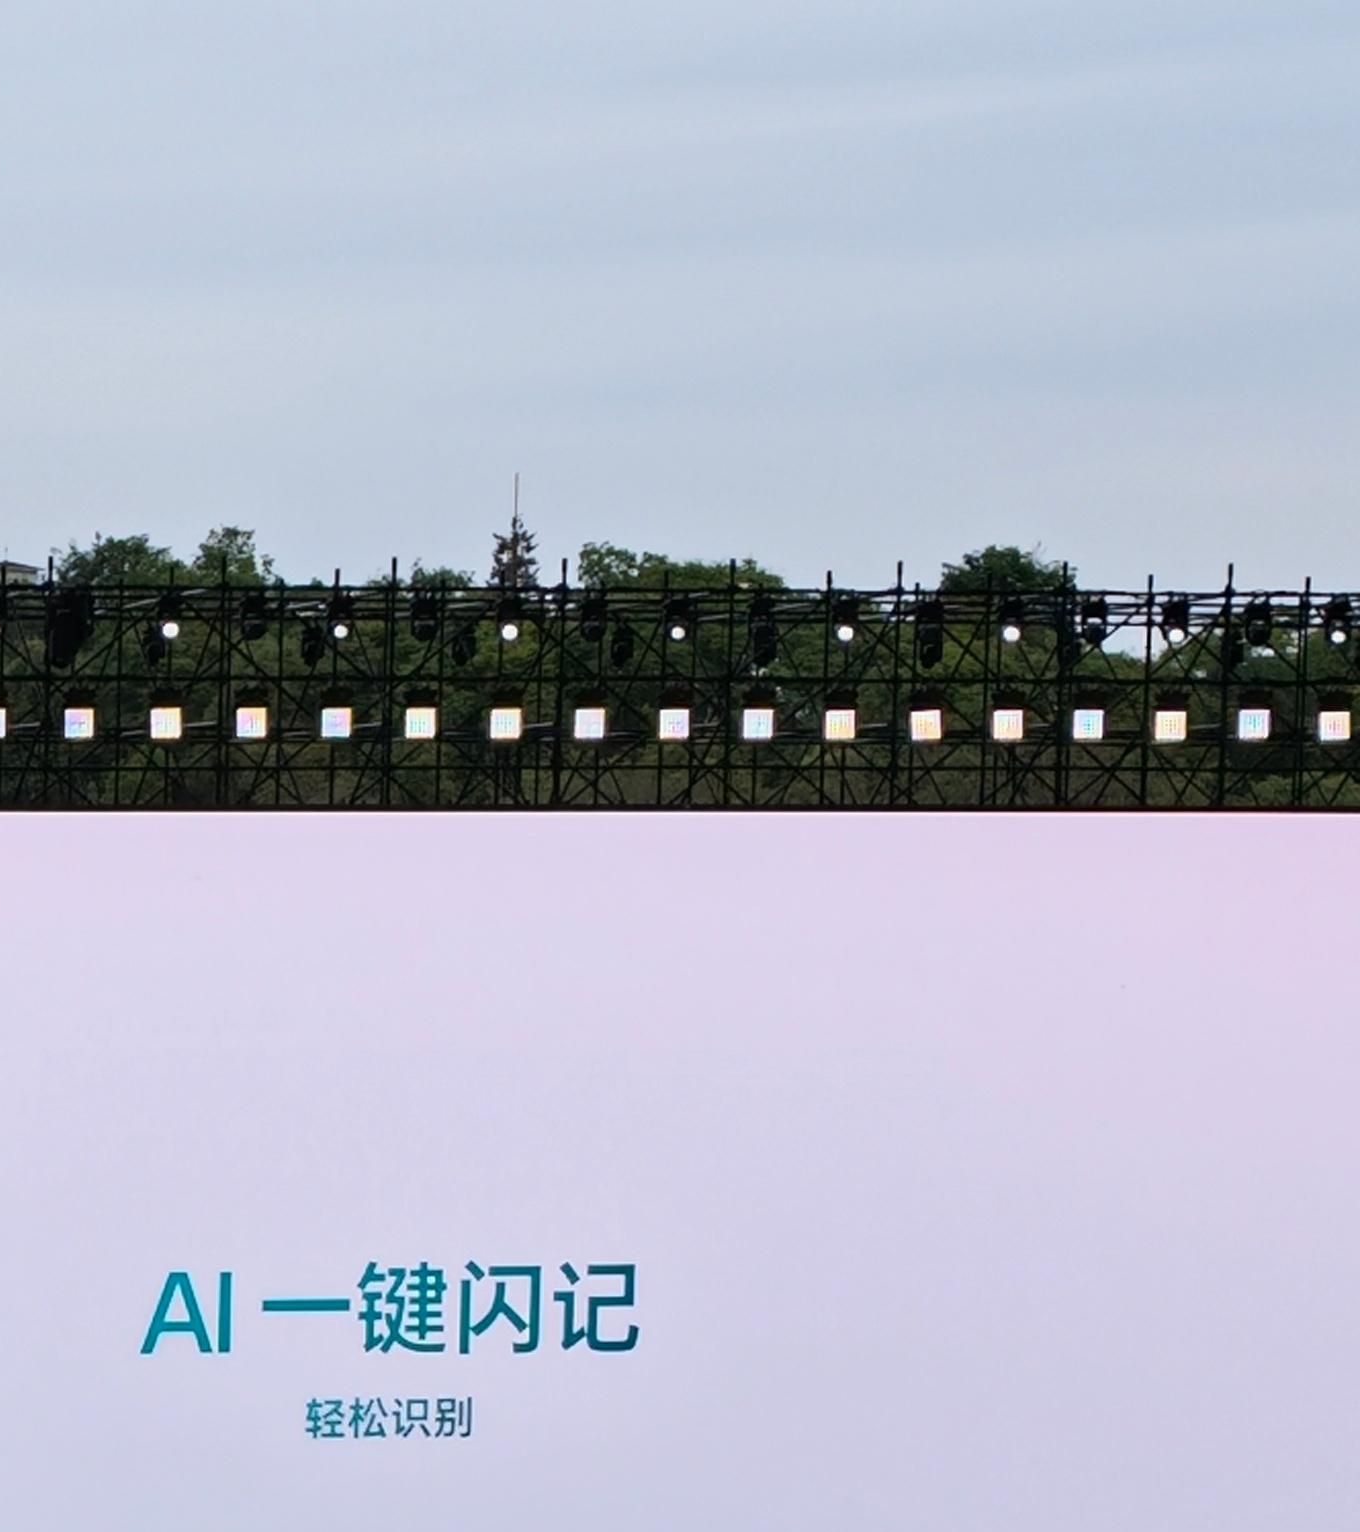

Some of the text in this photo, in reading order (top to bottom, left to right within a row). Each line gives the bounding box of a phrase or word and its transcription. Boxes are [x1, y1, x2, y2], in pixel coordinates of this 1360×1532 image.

[140, 1260, 640, 1355] AI 一键闪记
[305, 1396, 472, 1439] 轻松识别
